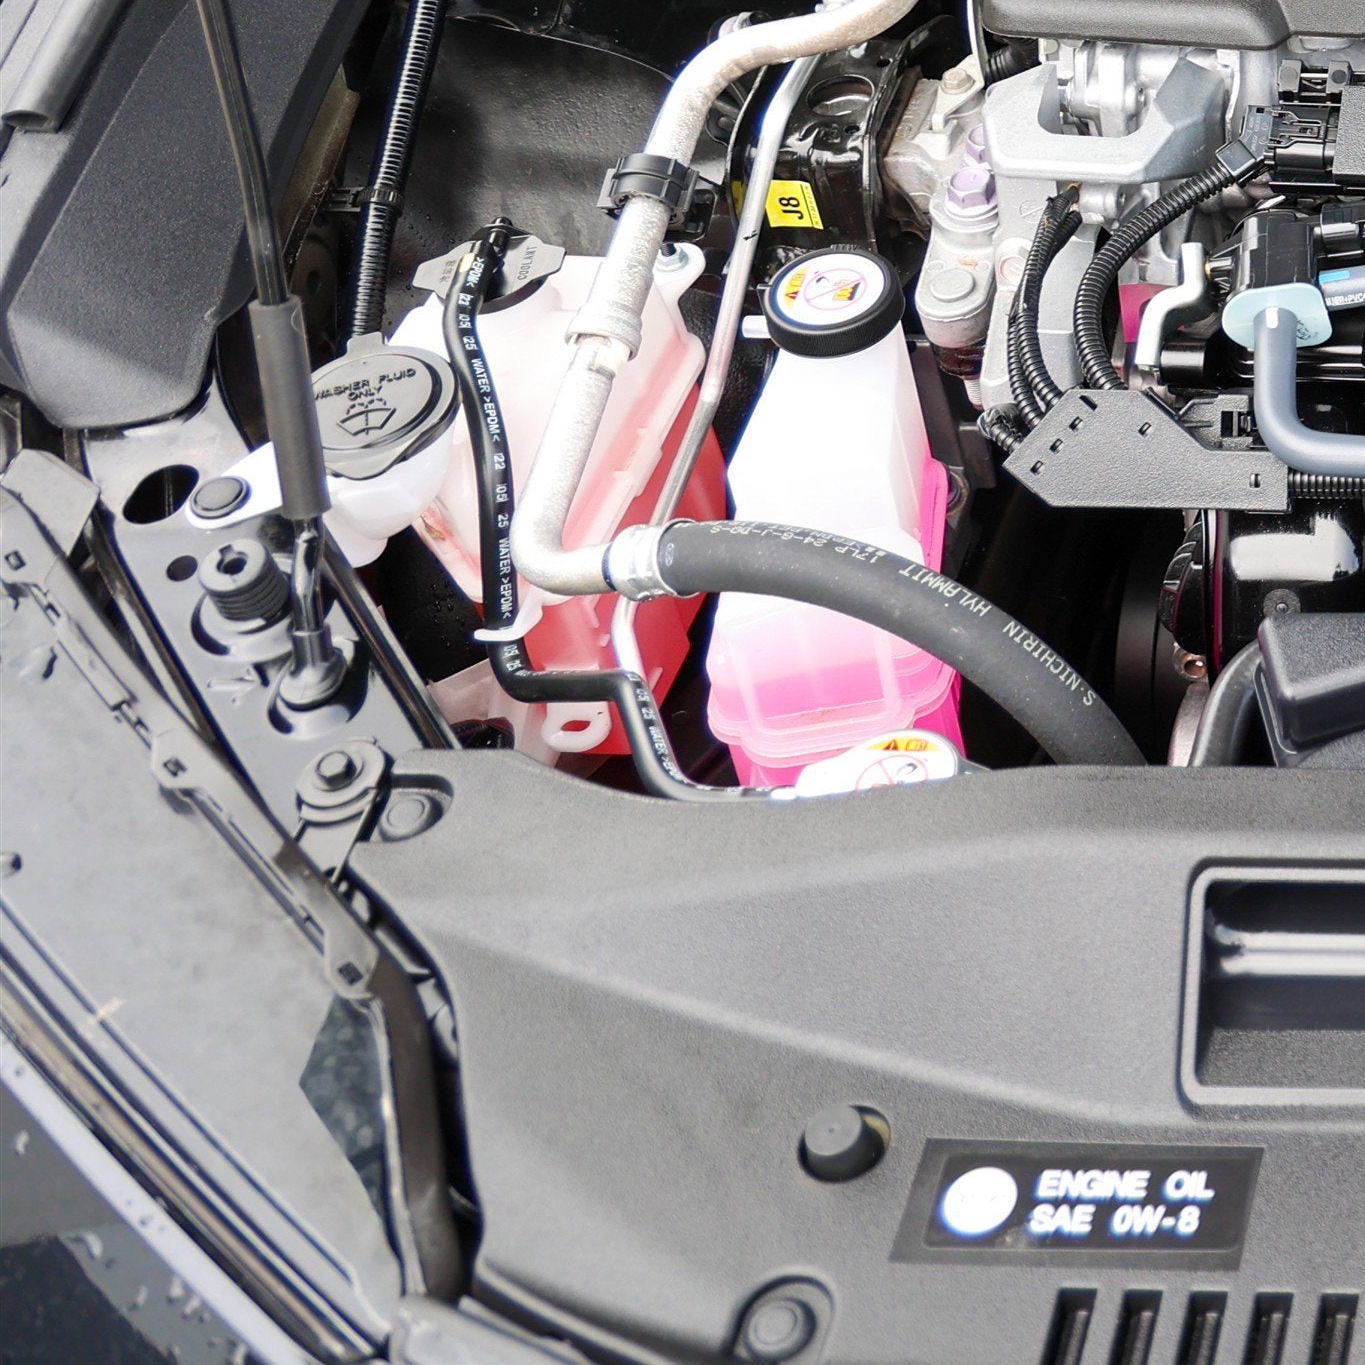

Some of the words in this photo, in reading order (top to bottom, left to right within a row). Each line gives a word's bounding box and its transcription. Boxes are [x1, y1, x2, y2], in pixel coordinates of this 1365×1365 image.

[779, 196, 804, 220] J8
[518, 245, 537, 280] COOLANT
[378, 368, 417, 384] FLUID
[347, 385, 383, 402] ONLY
[471, 358, 490, 393] WATER
[499, 537, 511, 579] WATER
[898, 563, 994, 617] HYLAMMIT
[1037, 1169, 1150, 1200] ENGINE
[1163, 1170, 1216, 1201] OIL
[1028, 1204, 1097, 1235] SAE
[1110, 1205, 1200, 1235] 0W-8
